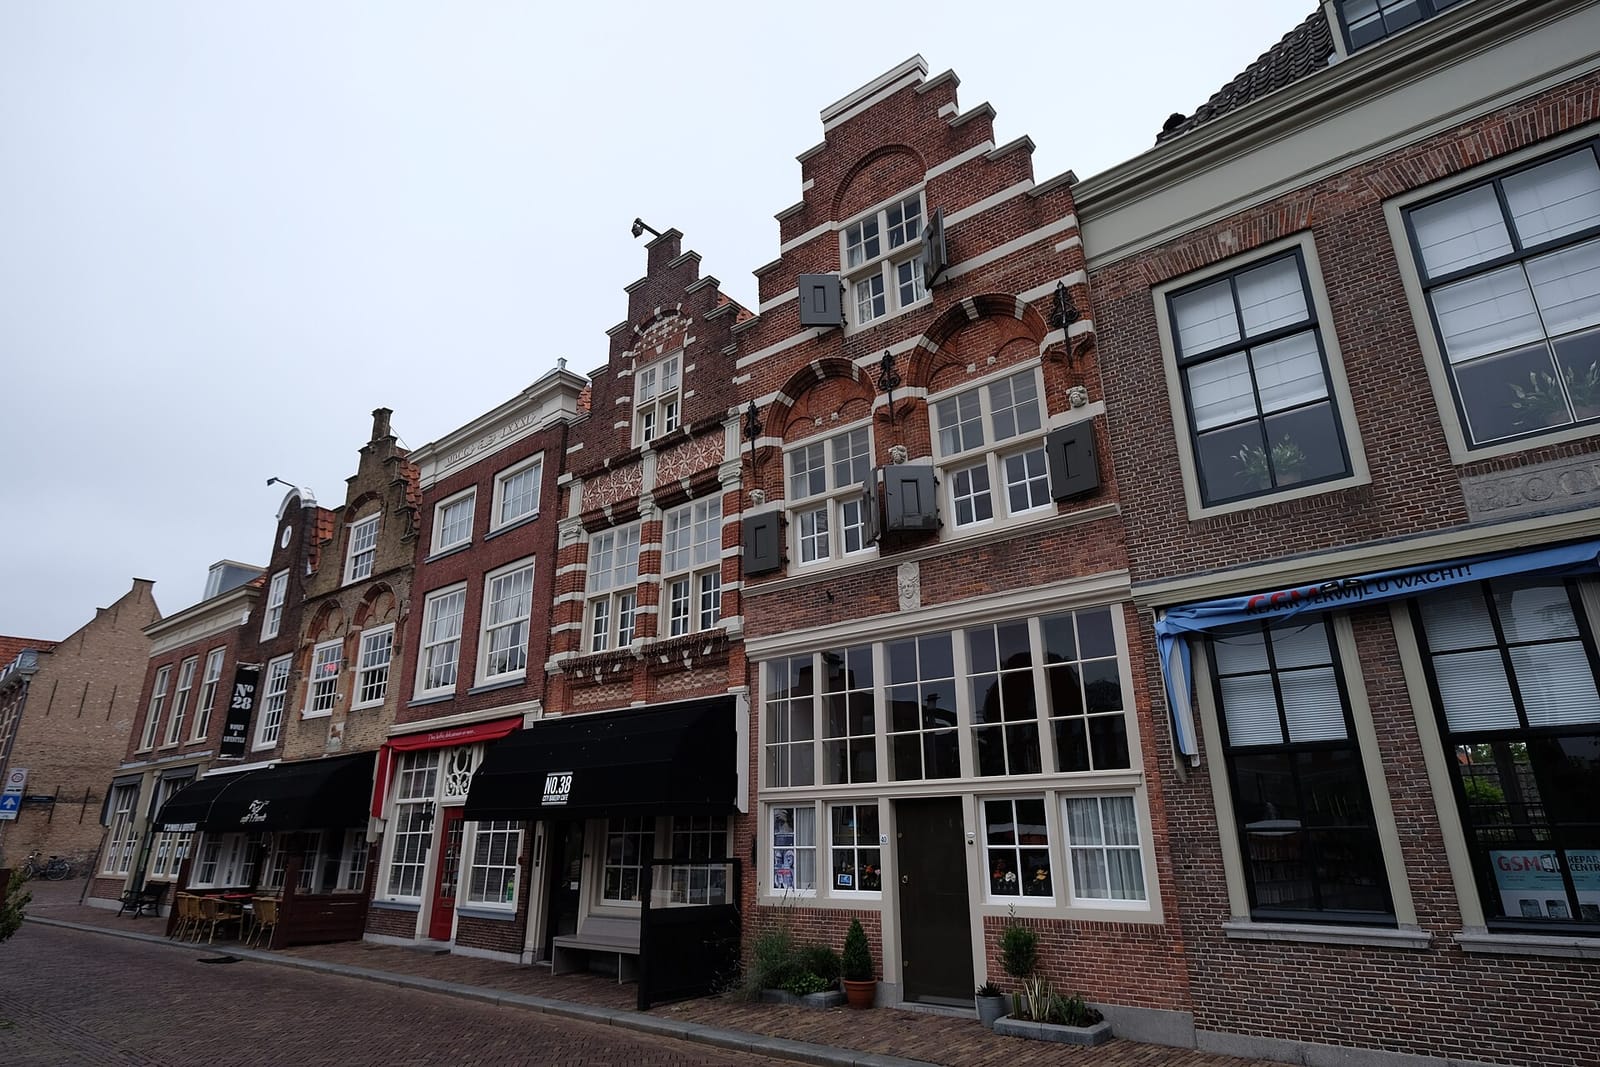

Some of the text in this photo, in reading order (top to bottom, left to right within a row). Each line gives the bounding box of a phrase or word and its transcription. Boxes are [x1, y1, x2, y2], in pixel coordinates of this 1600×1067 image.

[1376, 578, 1389, 593] U
[1392, 565, 1473, 589] WACHT!
[231, 696, 252, 709] 28
[543, 776, 573, 794] NO.38
[1497, 855, 1542, 872] GSM
